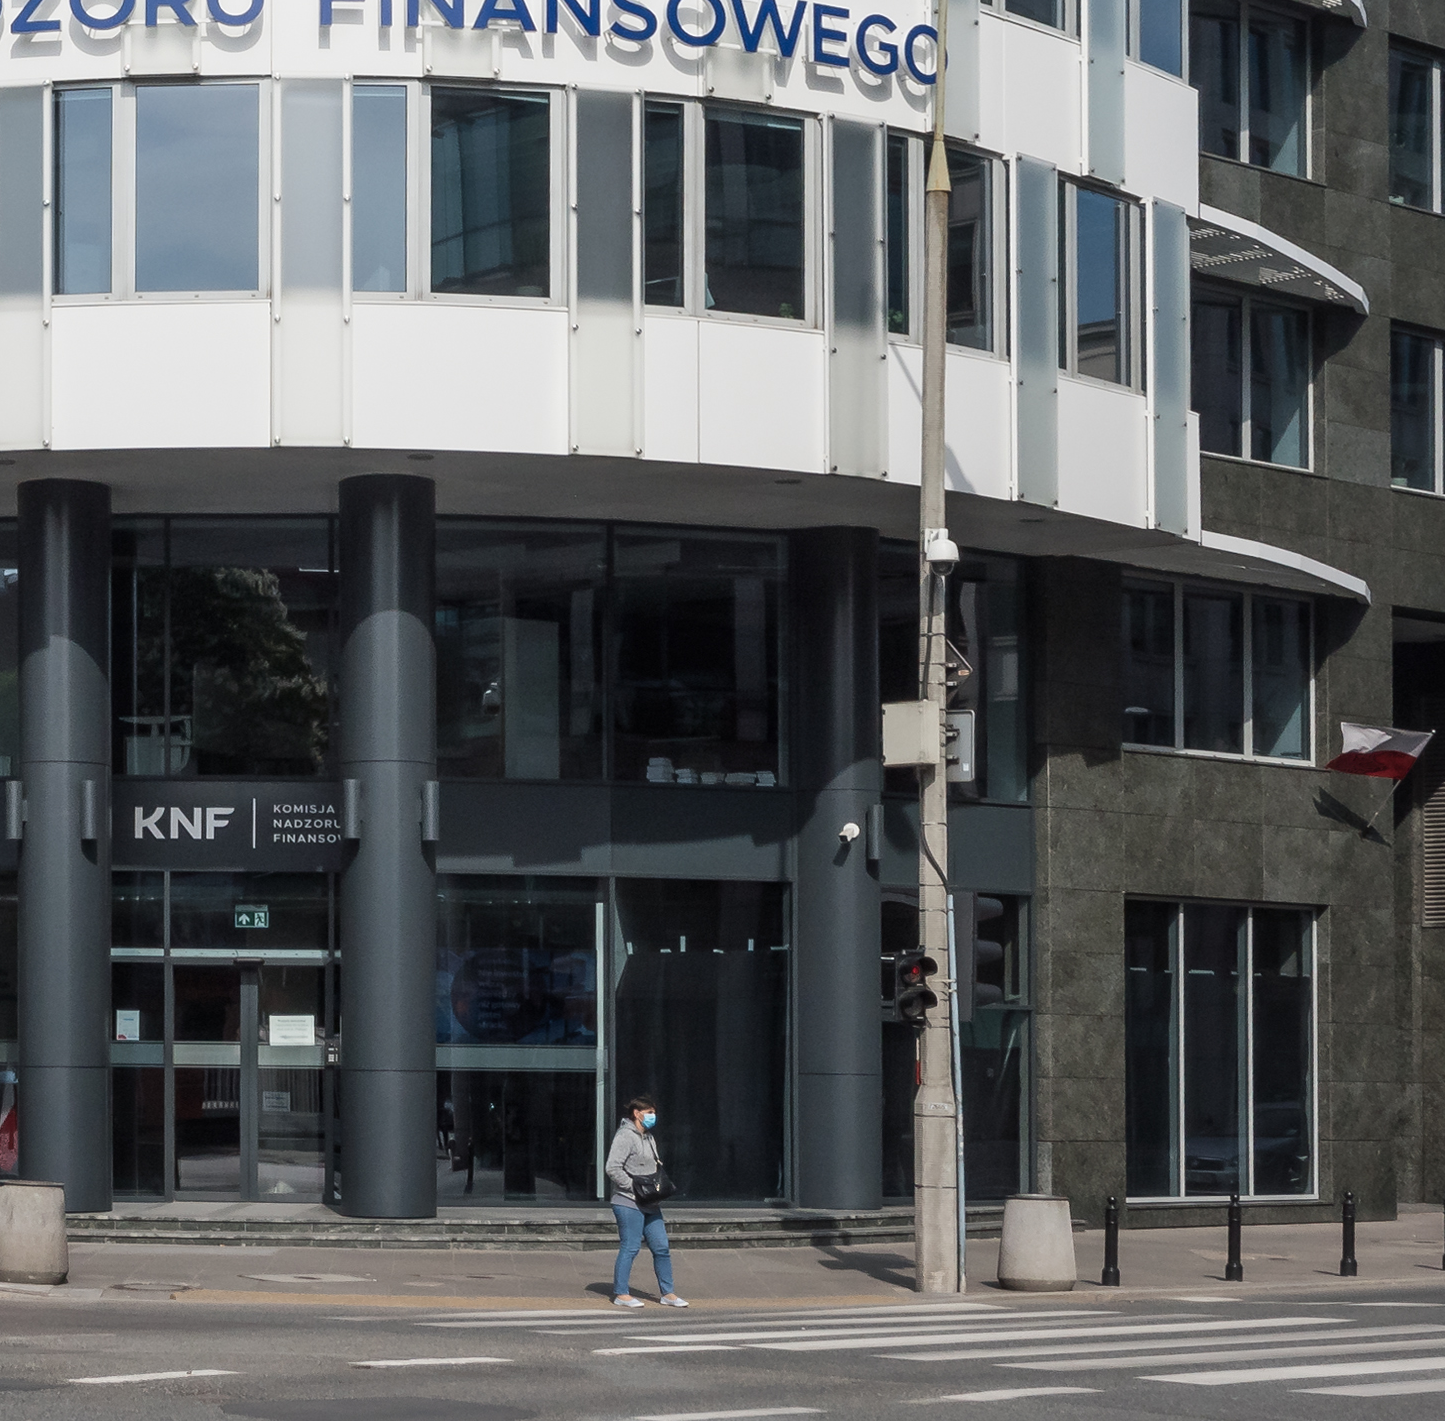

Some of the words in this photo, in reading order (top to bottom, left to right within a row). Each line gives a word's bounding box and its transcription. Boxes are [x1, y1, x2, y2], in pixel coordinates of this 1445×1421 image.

[273, 804, 336, 814] KOMISJA
[135, 806, 235, 840] KNF
[273, 833, 341, 844] FINANSO
